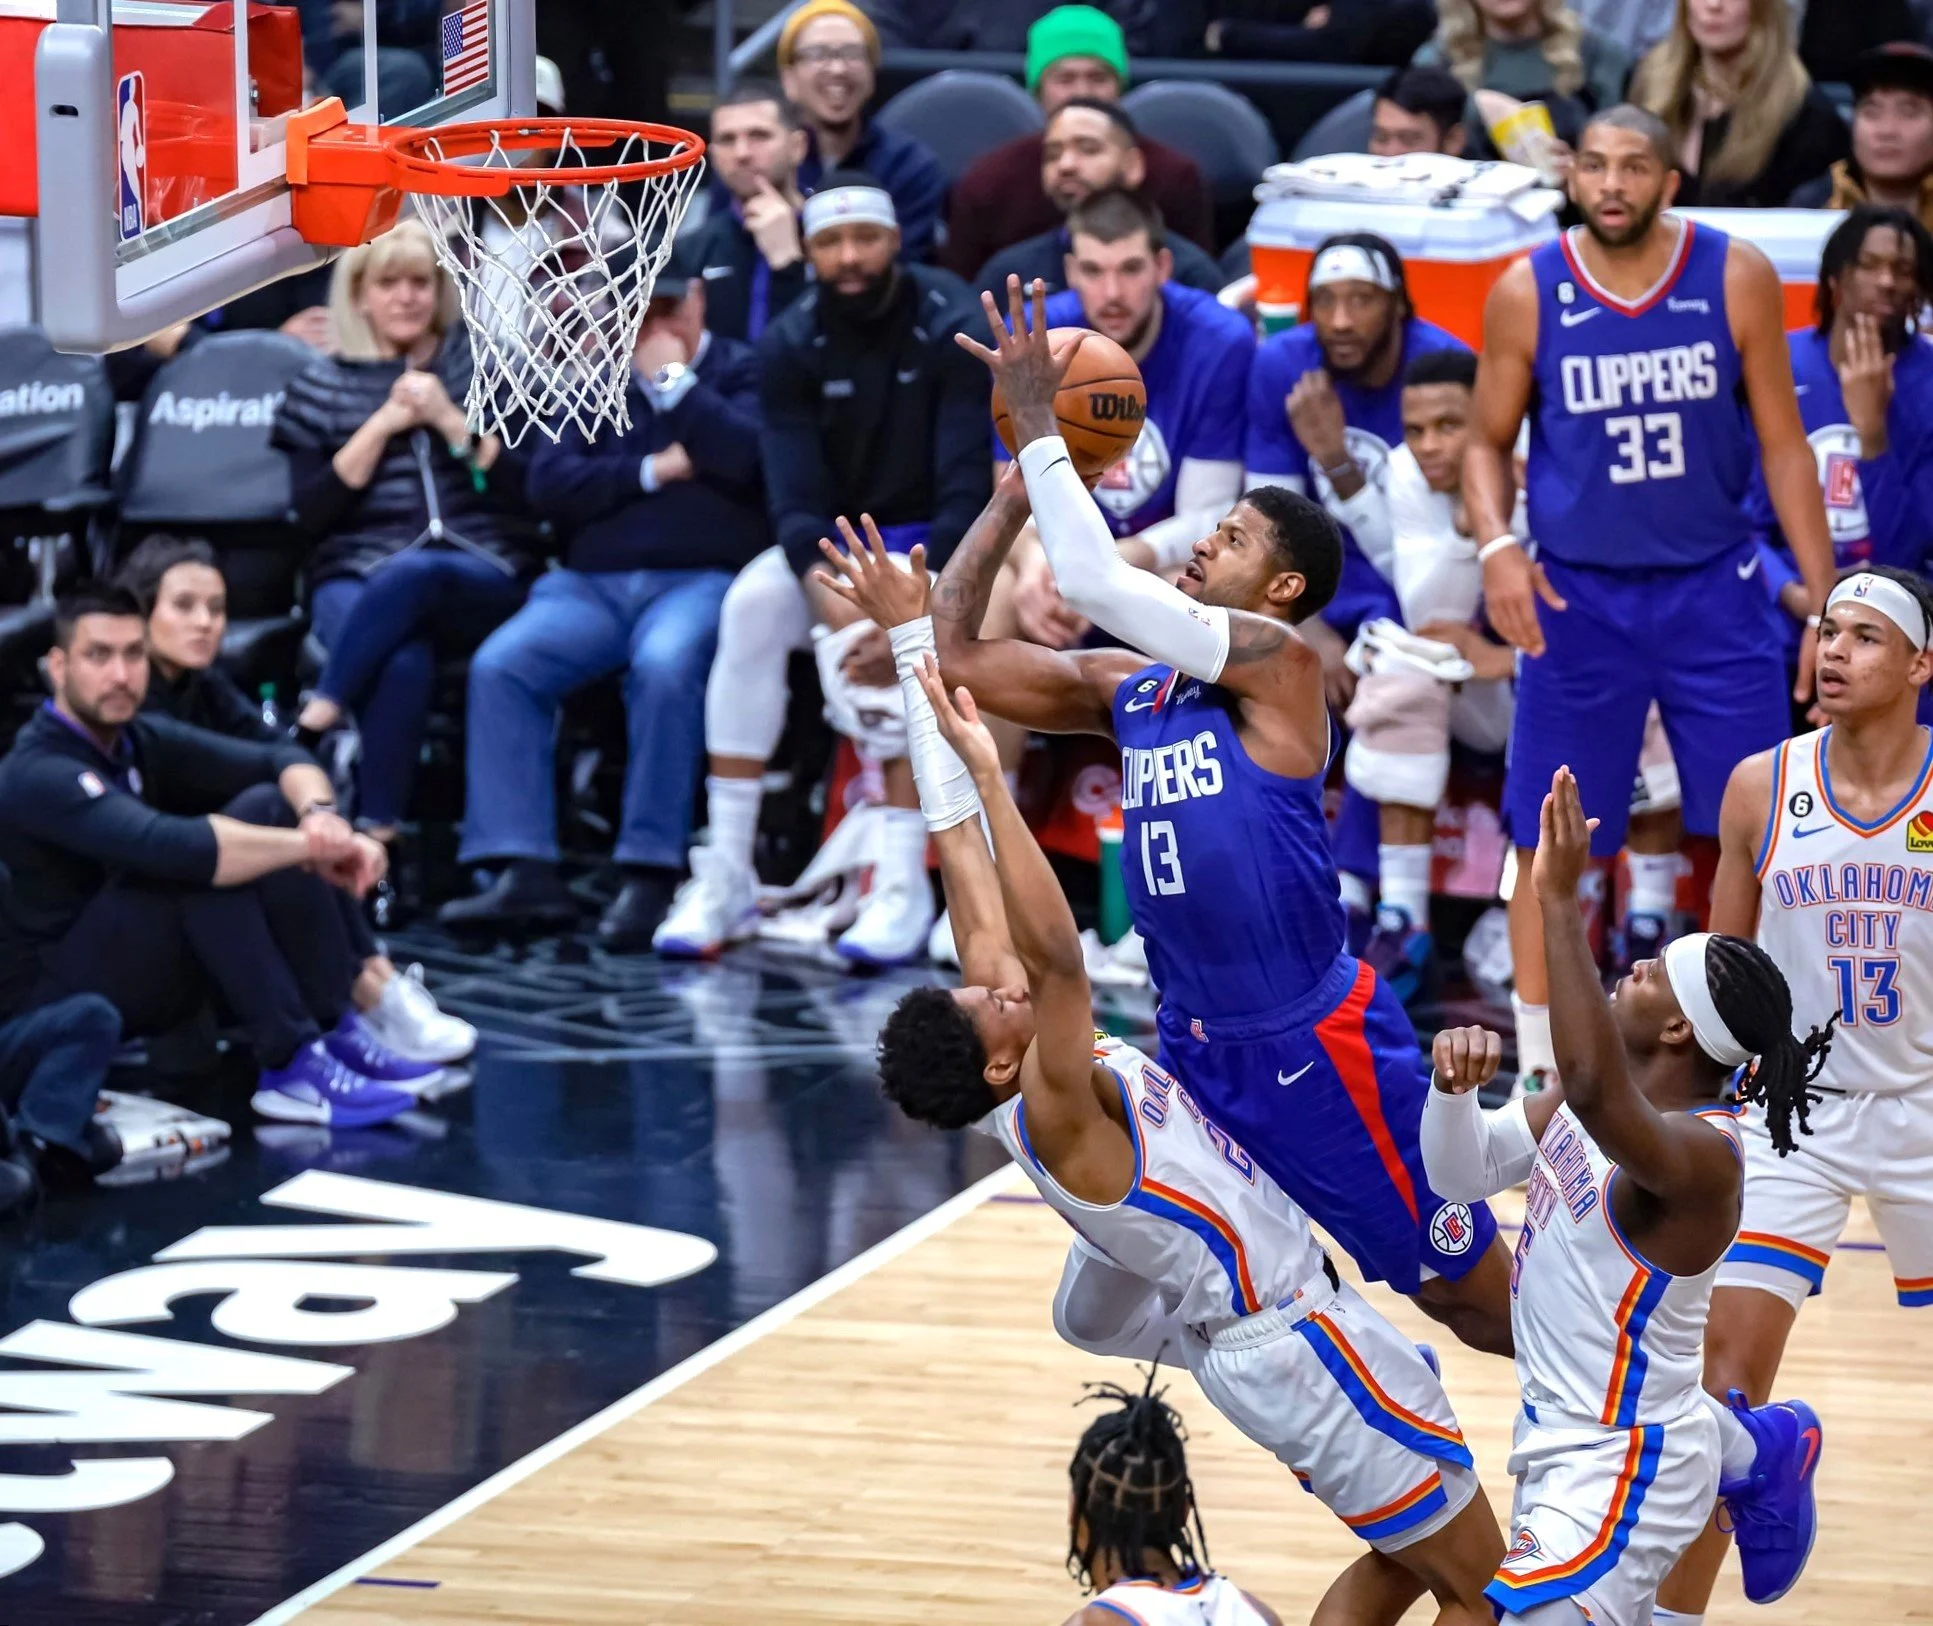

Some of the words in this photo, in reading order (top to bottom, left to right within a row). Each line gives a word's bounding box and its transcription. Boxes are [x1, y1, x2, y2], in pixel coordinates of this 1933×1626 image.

[1561, 341, 1718, 414] CLIPPERS
[149, 390, 287, 433] Aspirat
[1605, 412, 1686, 484] 33
[1137, 679, 1158, 693] 6
[1794, 793, 1812, 816] 6
[1141, 820, 1186, 896] 13
[1909, 836, 1933, 849] Lov
[1773, 862, 1933, 913] OKLAHOM
[1826, 909, 1901, 950] CITY
[1828, 956, 1903, 1027] 13
[1526, 1163, 1558, 1231] CITY
